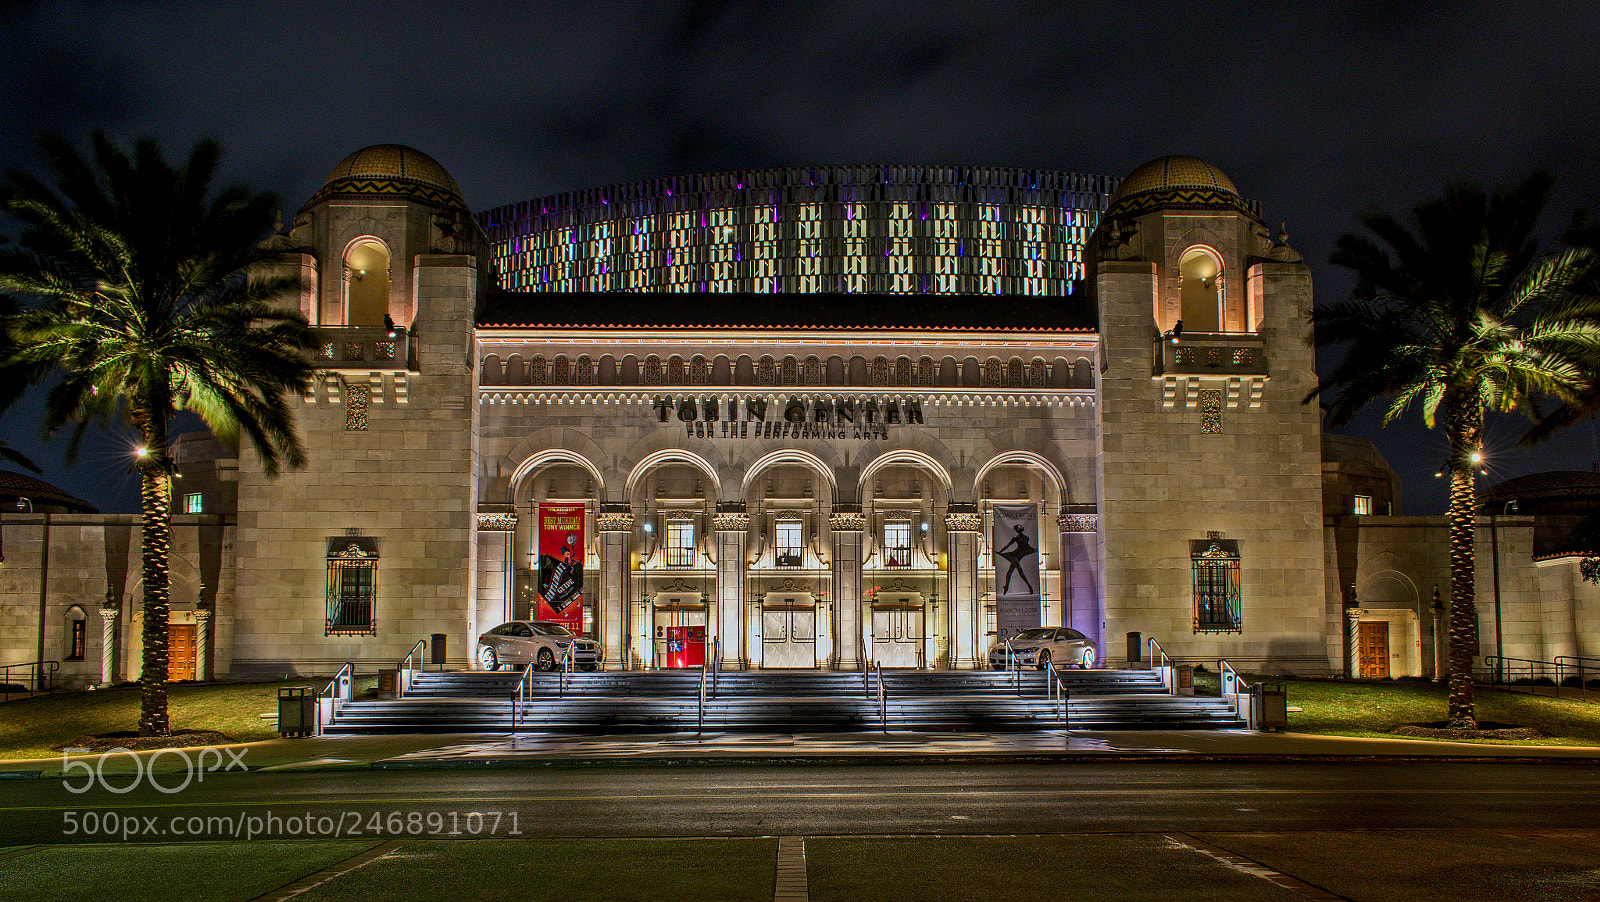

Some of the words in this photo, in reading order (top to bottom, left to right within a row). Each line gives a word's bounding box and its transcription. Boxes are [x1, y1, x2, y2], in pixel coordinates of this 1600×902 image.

[653, 402, 767, 422] TOBIN
[784, 405, 924, 424] CENTER
[687, 430, 714, 439] FOR
[721, 430, 748, 439] THE
[755, 430, 846, 440] PERFORMING
[853, 431, 889, 440] ARTS
[543, 516, 557, 525] BEST
[557, 578, 575, 594] GUIDE
[571, 622, 579, 630] 11
